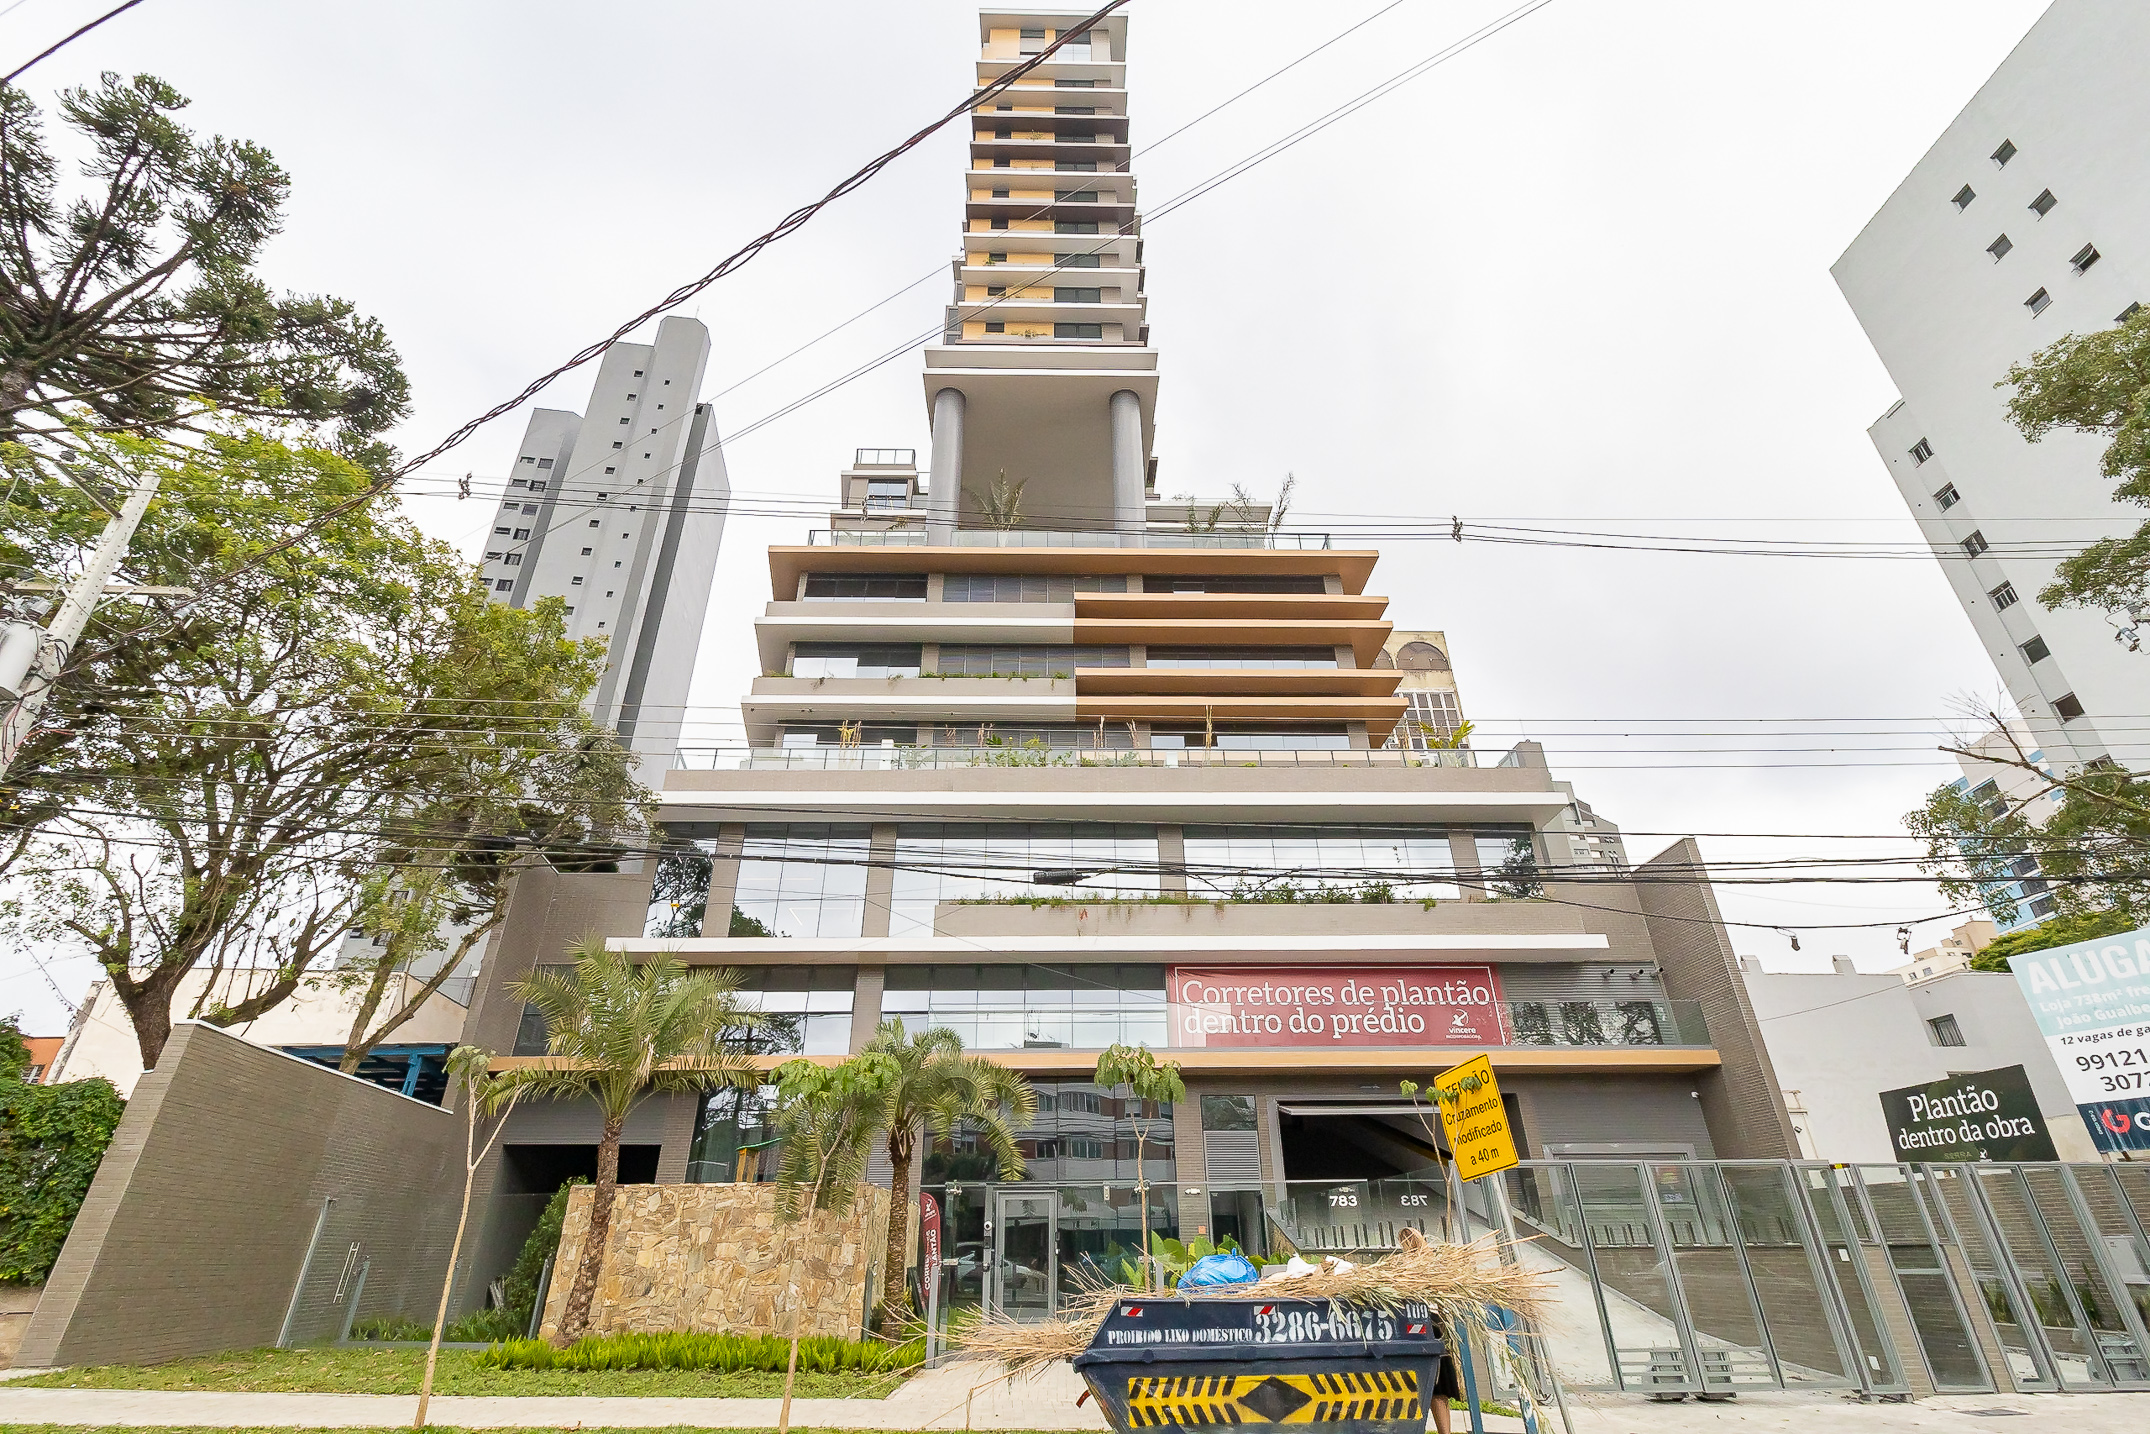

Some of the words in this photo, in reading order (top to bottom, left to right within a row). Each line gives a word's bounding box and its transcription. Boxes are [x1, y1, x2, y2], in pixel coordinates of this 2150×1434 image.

[1183, 980, 1334, 1006] Corretores
[1340, 979, 1375, 1005] de
[1380, 979, 1490, 1012] plantão
[2039, 999, 2072, 1014] Loja
[1184, 1008, 1282, 1034] dentro
[1288, 1008, 1324, 1034] do
[1333, 1006, 1425, 1039] prédio
[2056, 1013, 2091, 1030] João
[2061, 1036, 2074, 1045] 12
[2077, 1031, 2113, 1044] vagas
[2117, 1027, 2132, 1037] de
[1445, 1097, 1498, 1126] Cruzamento
[1907, 1085, 1999, 1122] Plantão
[1898, 1126, 1957, 1150] dentro
[1959, 1119, 1985, 1143] da
[1985, 1115, 2036, 1139] obra
[1471, 1154, 1478, 1166] a
[1478, 1147, 1490, 1163] 40
[1491, 1147, 1500, 1159] m
[1329, 1195, 1358, 1207] 783
[1107, 1329, 1162, 1345] PROIBIDO
[1164, 1328, 1190, 1343] LIXO
[1255, 1311, 1393, 1344] 3286-6675
